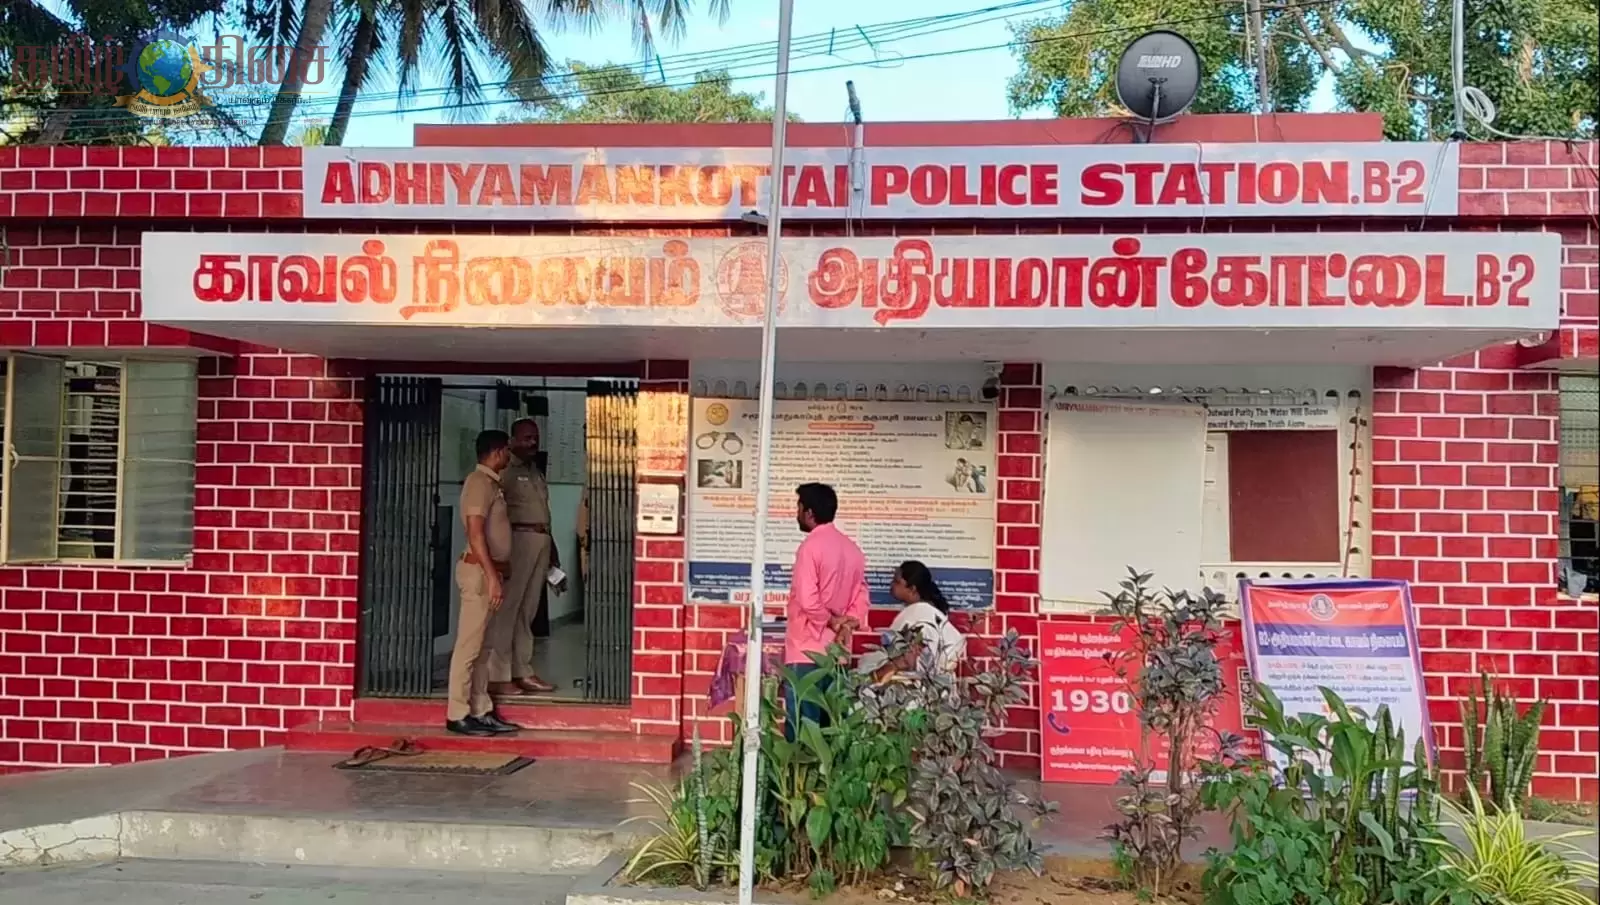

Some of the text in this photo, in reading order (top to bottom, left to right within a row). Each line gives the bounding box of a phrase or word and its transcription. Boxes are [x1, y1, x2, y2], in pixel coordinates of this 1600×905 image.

[321, 161, 850, 207] ADHIYAMANKOTTAI
[869, 162, 1058, 206] POLICE
[193, 239, 397, 304] காவல்
[399, 239, 702, 320] நிலையம்
[1051, 689, 1131, 714] 1930
